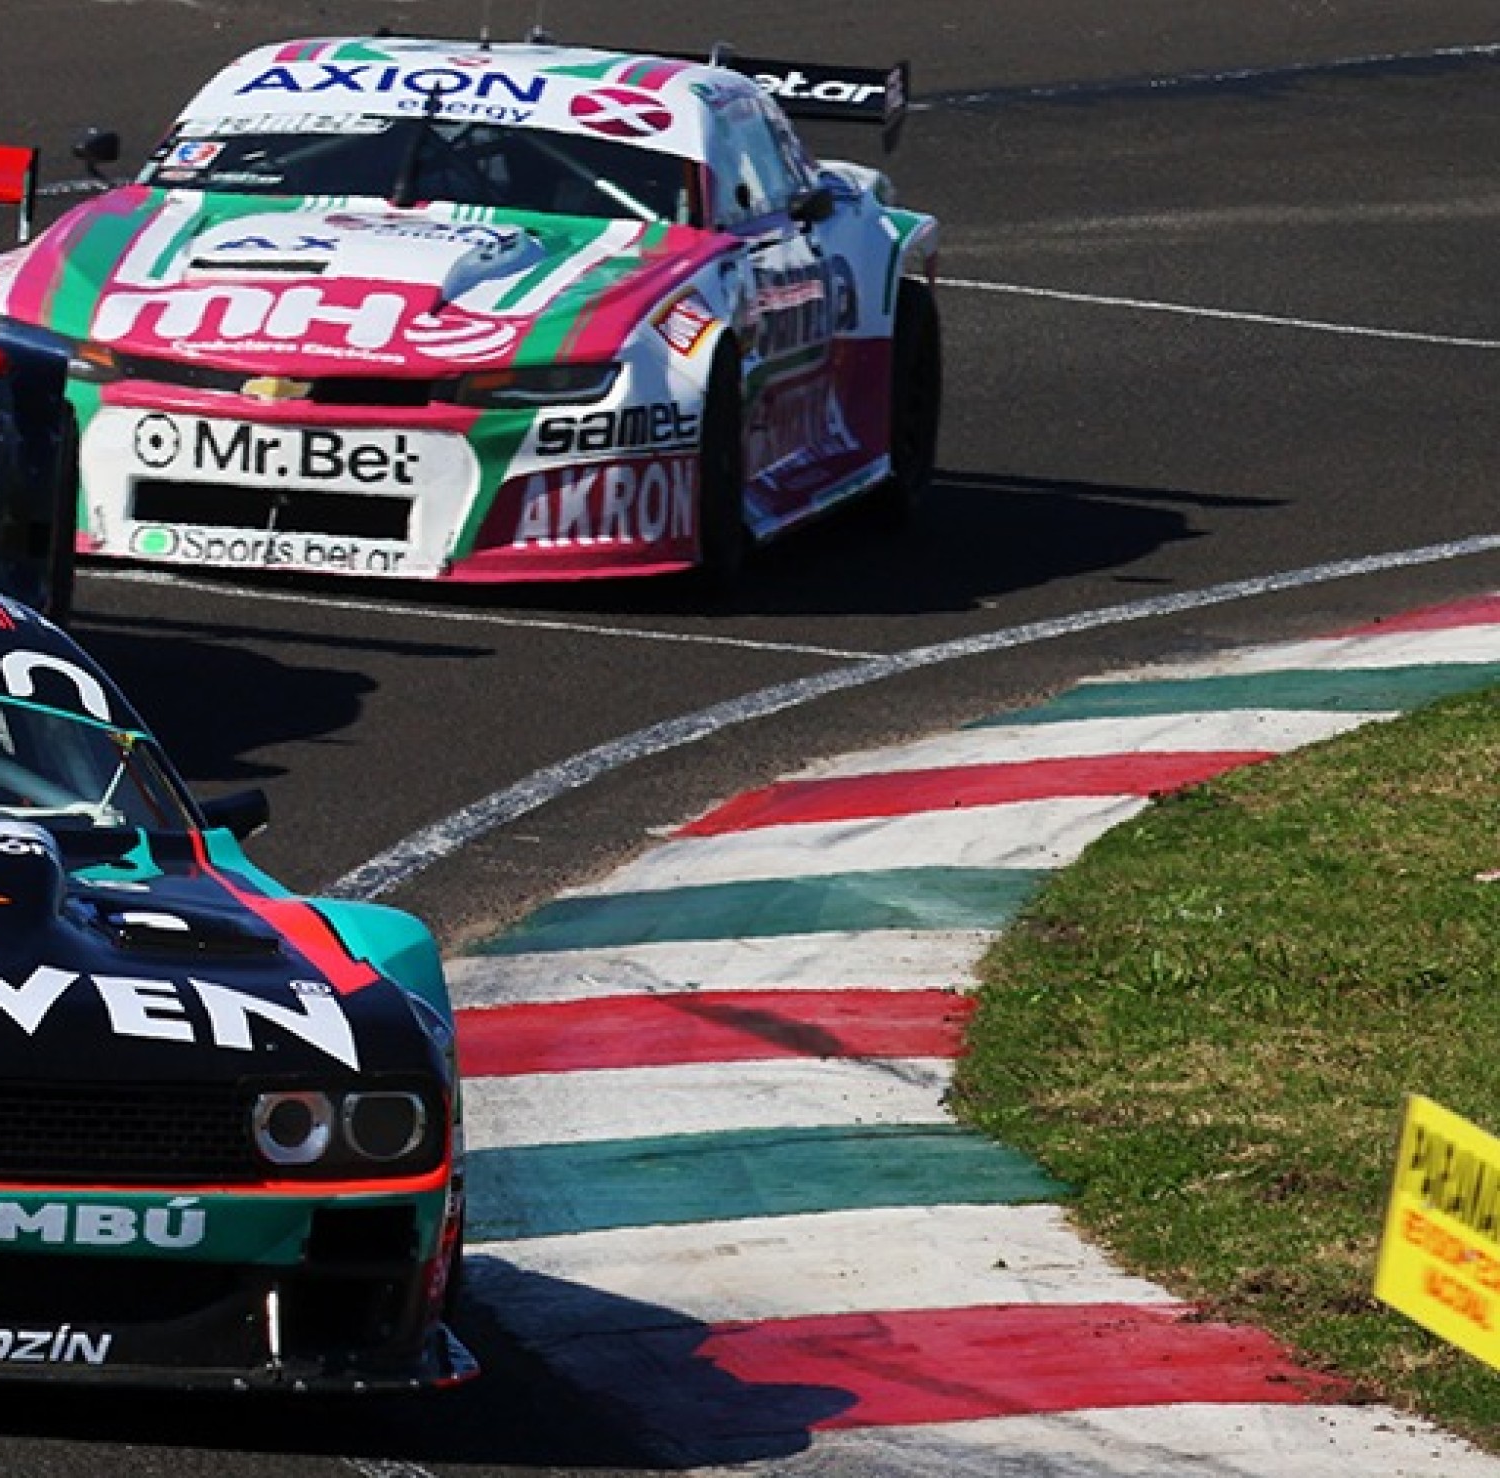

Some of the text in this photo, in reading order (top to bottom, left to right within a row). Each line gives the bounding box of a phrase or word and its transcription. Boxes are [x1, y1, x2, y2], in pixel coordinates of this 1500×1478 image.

[234, 65, 547, 104] AXION
[752, 72, 886, 104] et.ar
[397, 98, 534, 123] energy
[194, 420, 420, 484] Mr.Bet
[535, 402, 698, 456] samet
[513, 458, 696, 548] AKRON
